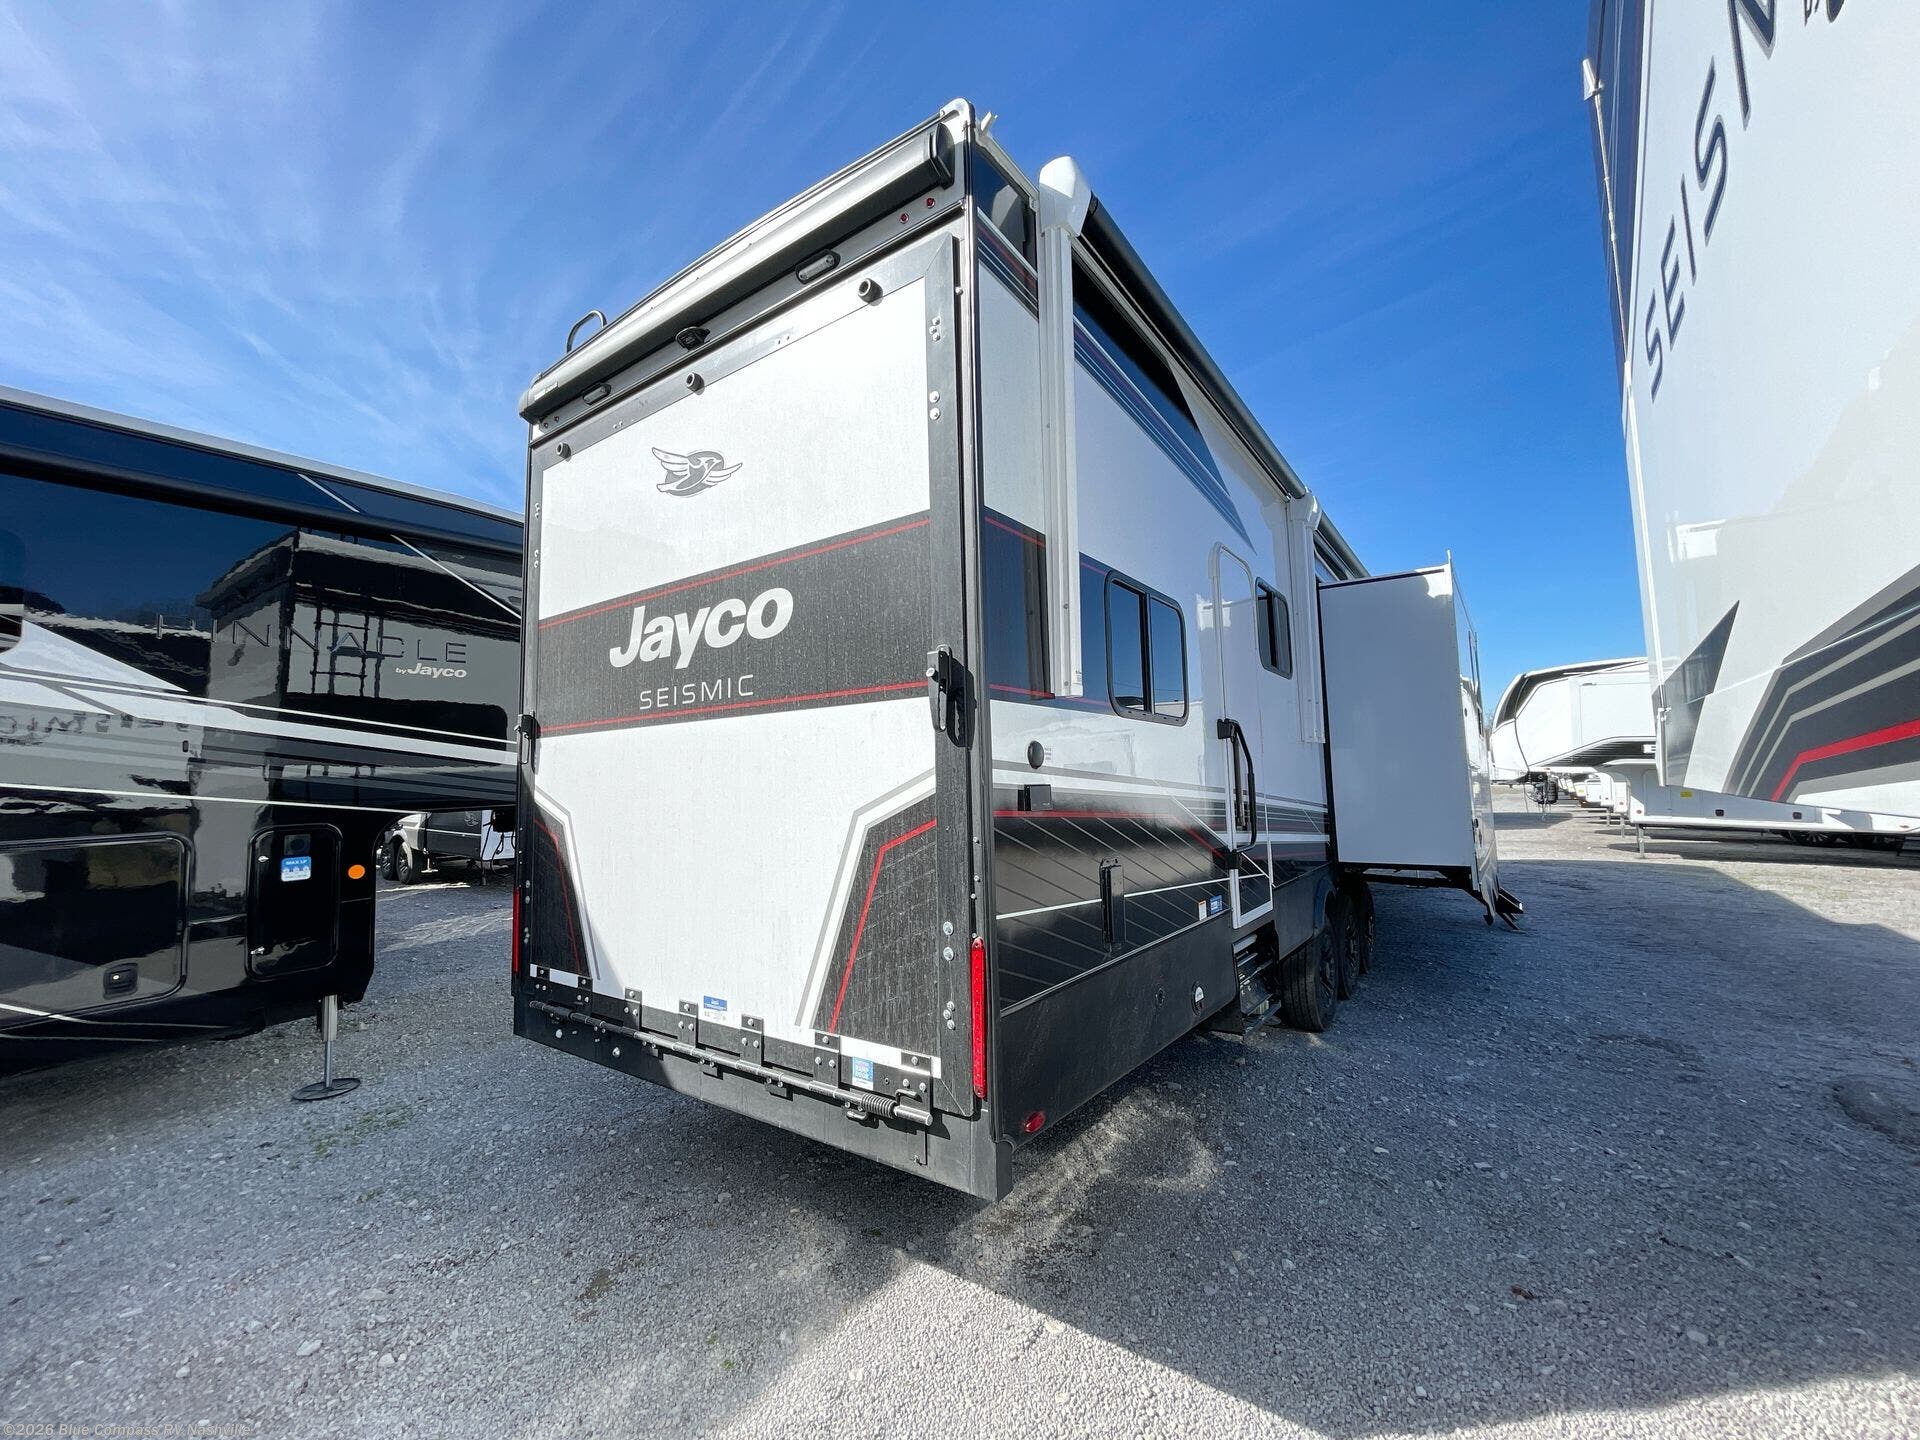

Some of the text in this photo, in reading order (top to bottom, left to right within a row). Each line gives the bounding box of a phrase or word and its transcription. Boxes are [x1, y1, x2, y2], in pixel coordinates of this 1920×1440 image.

[609, 588, 794, 670] Jayco
[395, 662, 467, 679] by Jayco
[640, 674, 754, 710] SEISMIC
